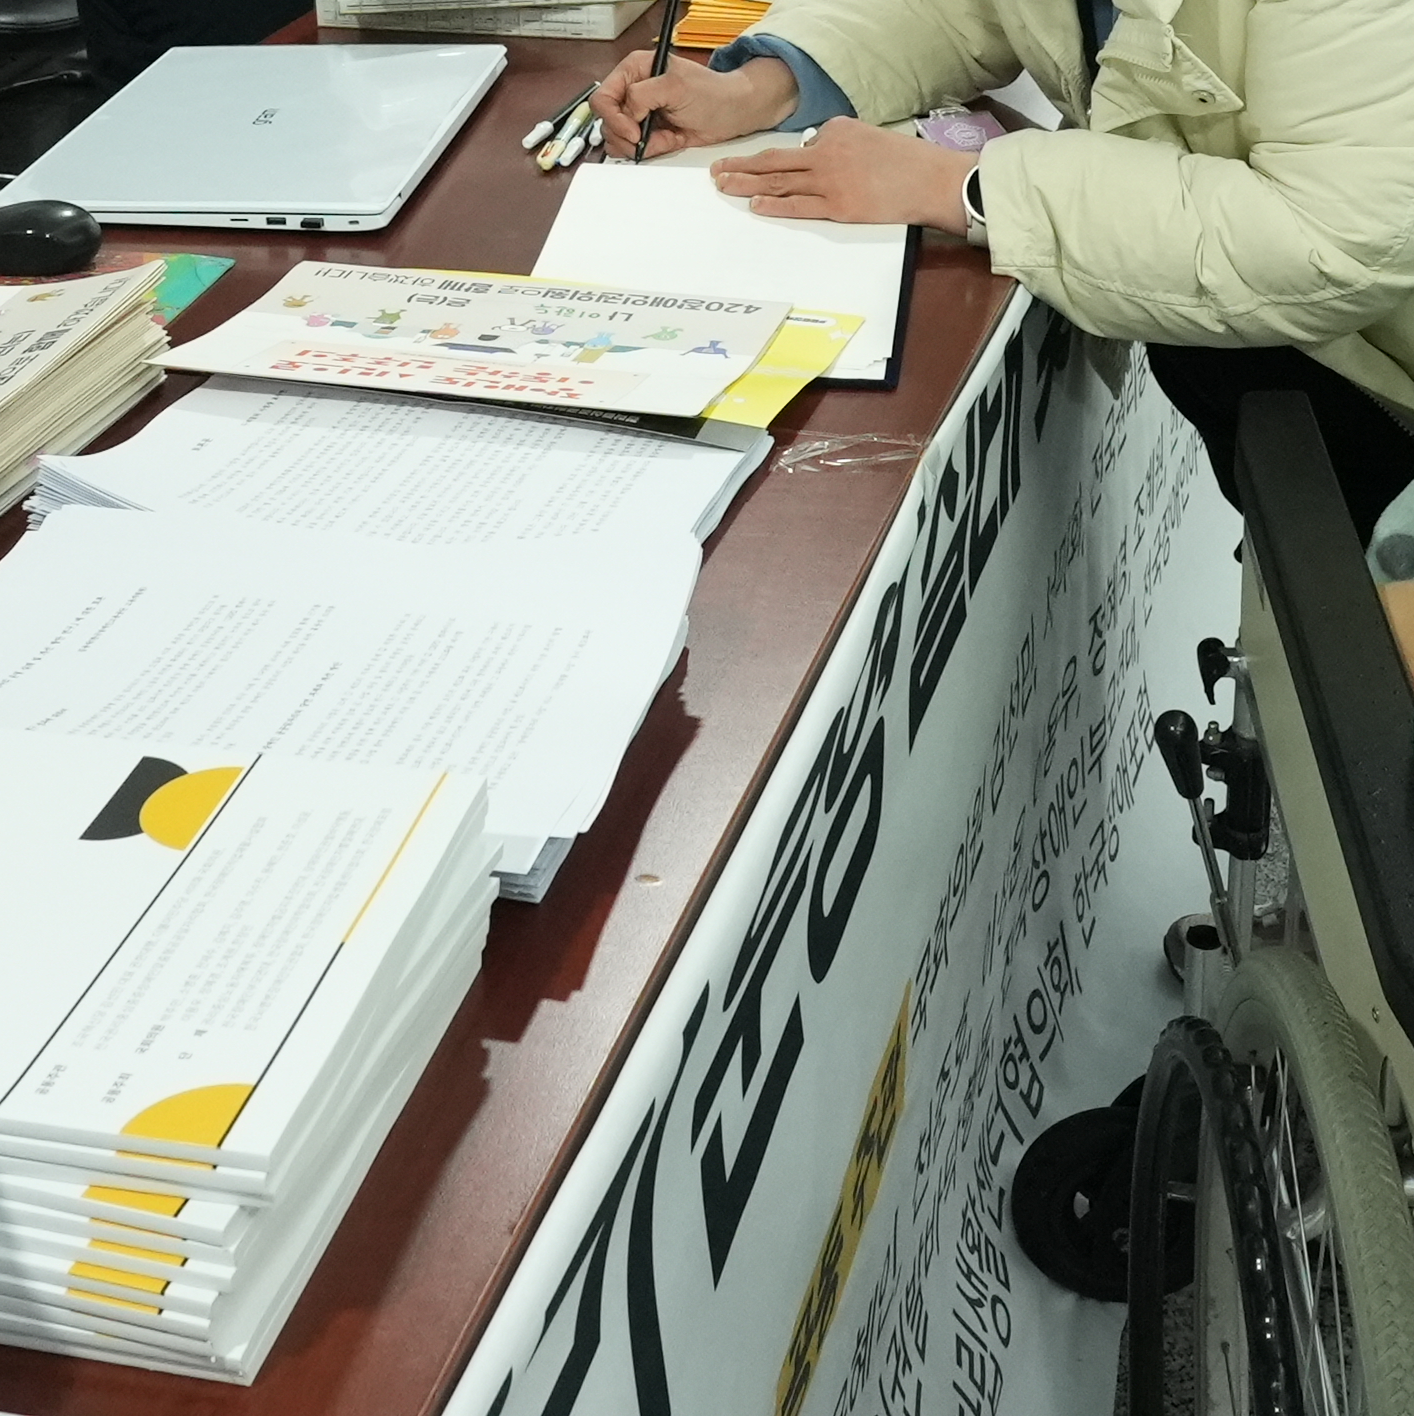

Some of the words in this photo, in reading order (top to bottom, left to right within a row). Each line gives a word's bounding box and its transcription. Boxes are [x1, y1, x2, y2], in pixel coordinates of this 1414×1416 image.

[436, 278, 494, 296] 함께
[495, 285, 763, 316] 420장애인권위원으로
[269, 359, 415, 382] 시민으로
[428, 374, 582, 401] 장애인도
[1073, 668, 1155, 950] 한국장애포럼
[911, 764, 987, 1048] 국회의원
